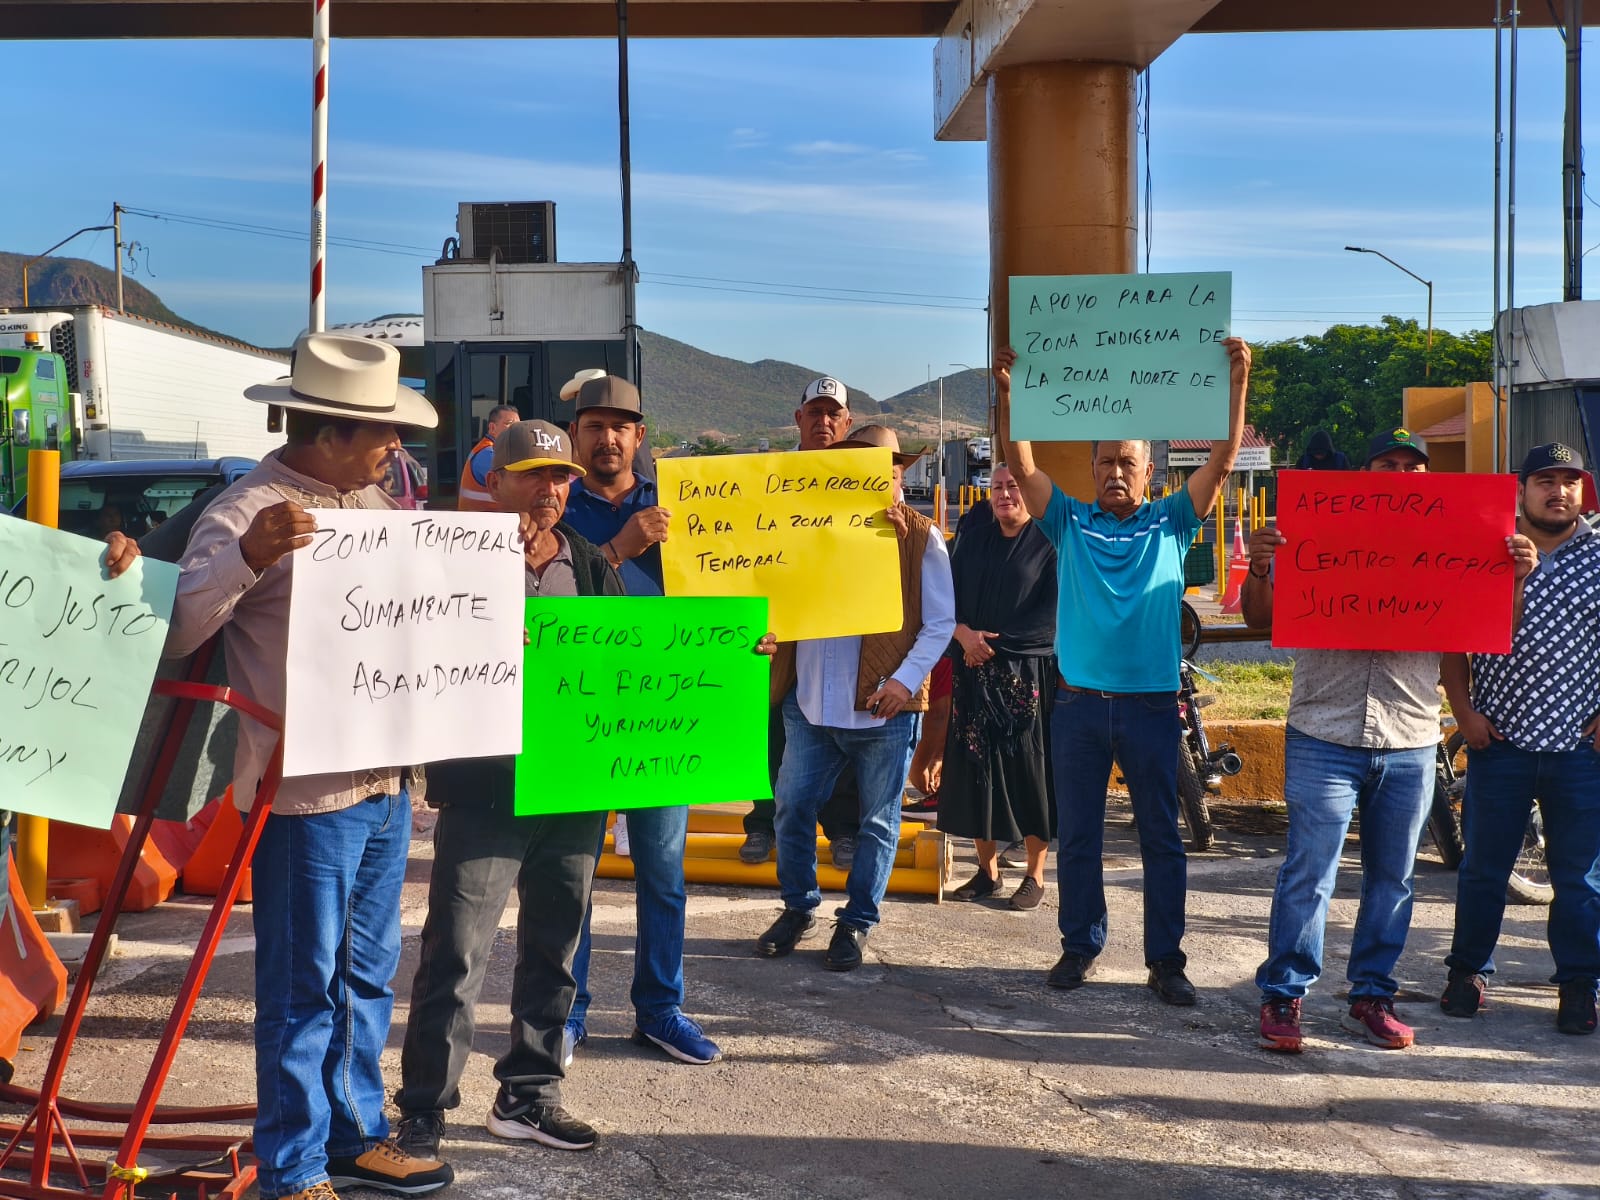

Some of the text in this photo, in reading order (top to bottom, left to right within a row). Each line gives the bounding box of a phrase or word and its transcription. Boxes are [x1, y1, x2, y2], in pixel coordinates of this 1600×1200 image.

[1029, 284, 1216, 315] APOYO PARA LA
[1026, 328, 1225, 353] ZONA INDIGENA DE
[1024, 365, 1217, 389] LA ZONA NORTE DE
[1052, 394, 1133, 416] SINALOA
[533, 428, 563, 452] LM
[679, 474, 890, 501] BANCA DESARROLLO
[1295, 491, 1446, 517] APERTURA
[313, 518, 521, 562] ZONA TEMPORAL
[687, 513, 874, 537] PARA LA ZONA DE
[696, 551, 789, 573] TEMPORAL
[1295, 538, 1511, 579] CENTRO ACOPIO
[43, 585, 160, 638] JUSTO
[341, 585, 494, 632] SUMAMENTE
[1294, 586, 1444, 626] YURIMUNY
[531, 611, 751, 650] PRECIOS JUSTOS
[0, 643, 99, 711] RIJOL
[353, 661, 517, 704] ABANDONADA
[557, 669, 724, 702] AL FRIJOL
[585, 712, 700, 743] YURIMUNY
[611, 753, 702, 779] NATIVO
